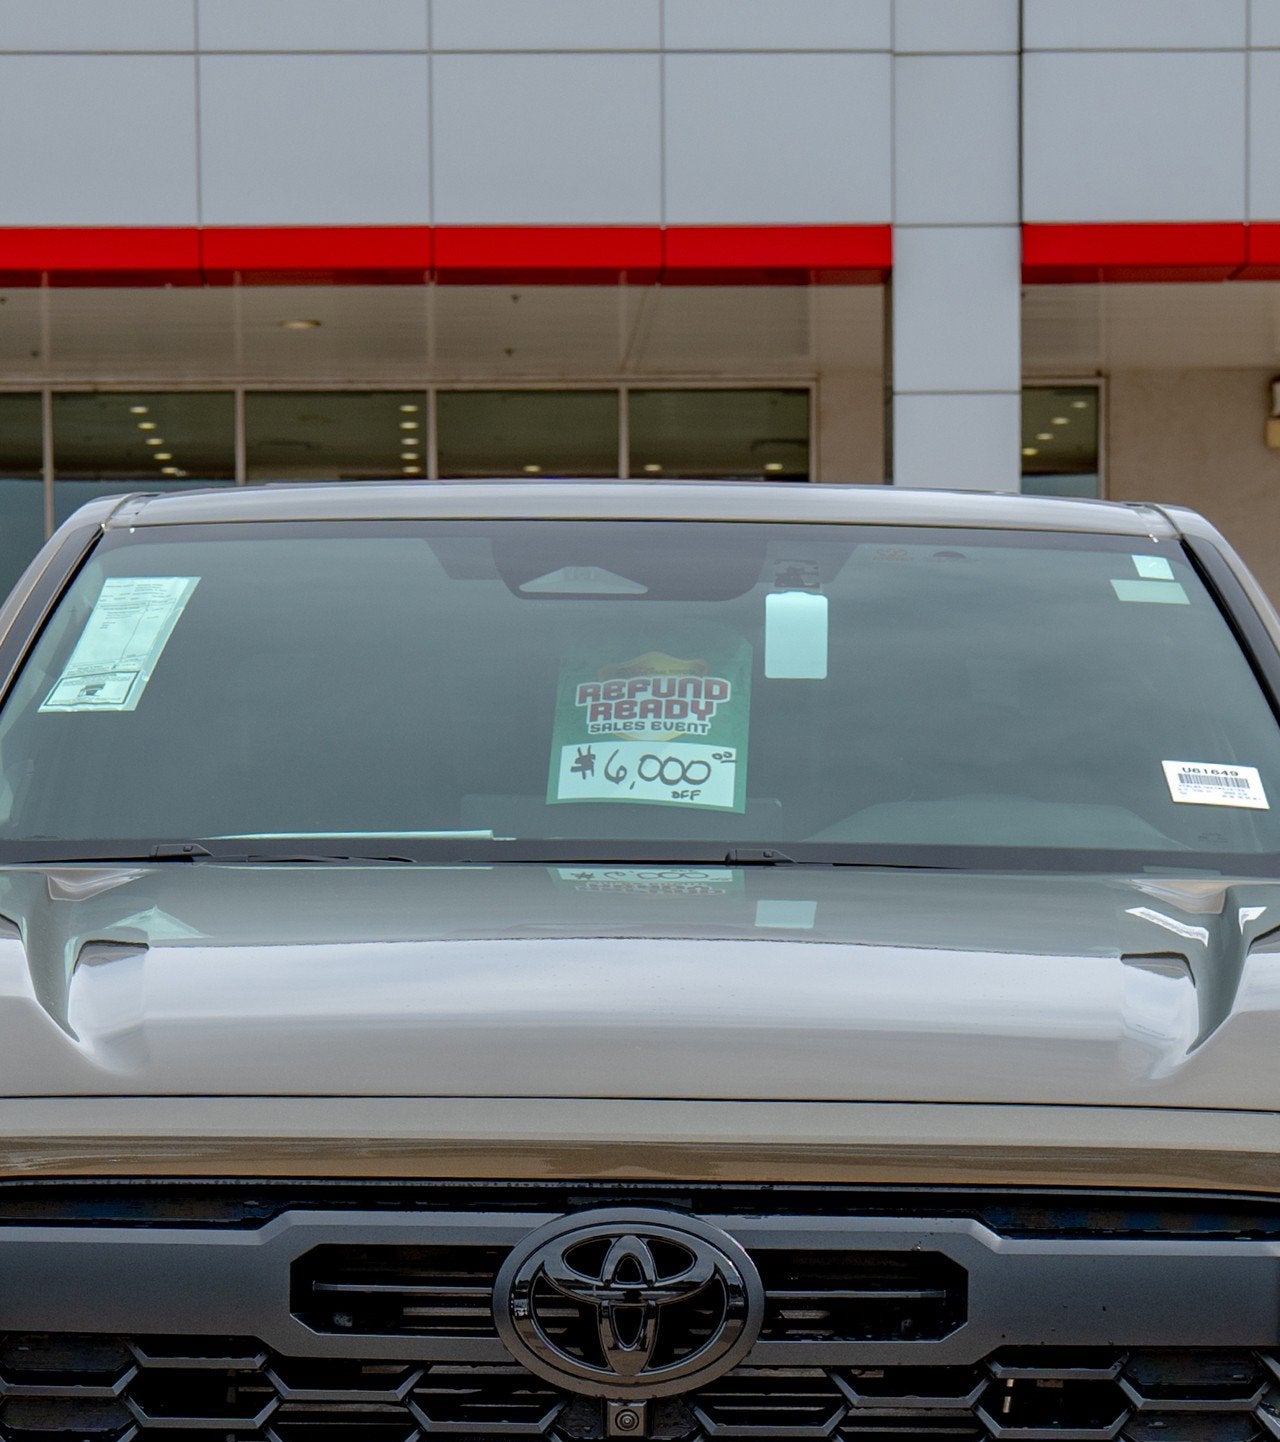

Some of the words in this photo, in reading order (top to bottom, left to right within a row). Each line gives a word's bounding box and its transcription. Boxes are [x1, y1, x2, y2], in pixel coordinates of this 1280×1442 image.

[577, 677, 729, 705] REFUND
[588, 699, 714, 722] READY
[590, 721, 646, 733] SALES
[650, 721, 709, 734] EVENT
[1181, 766, 1239, 777] U61649
